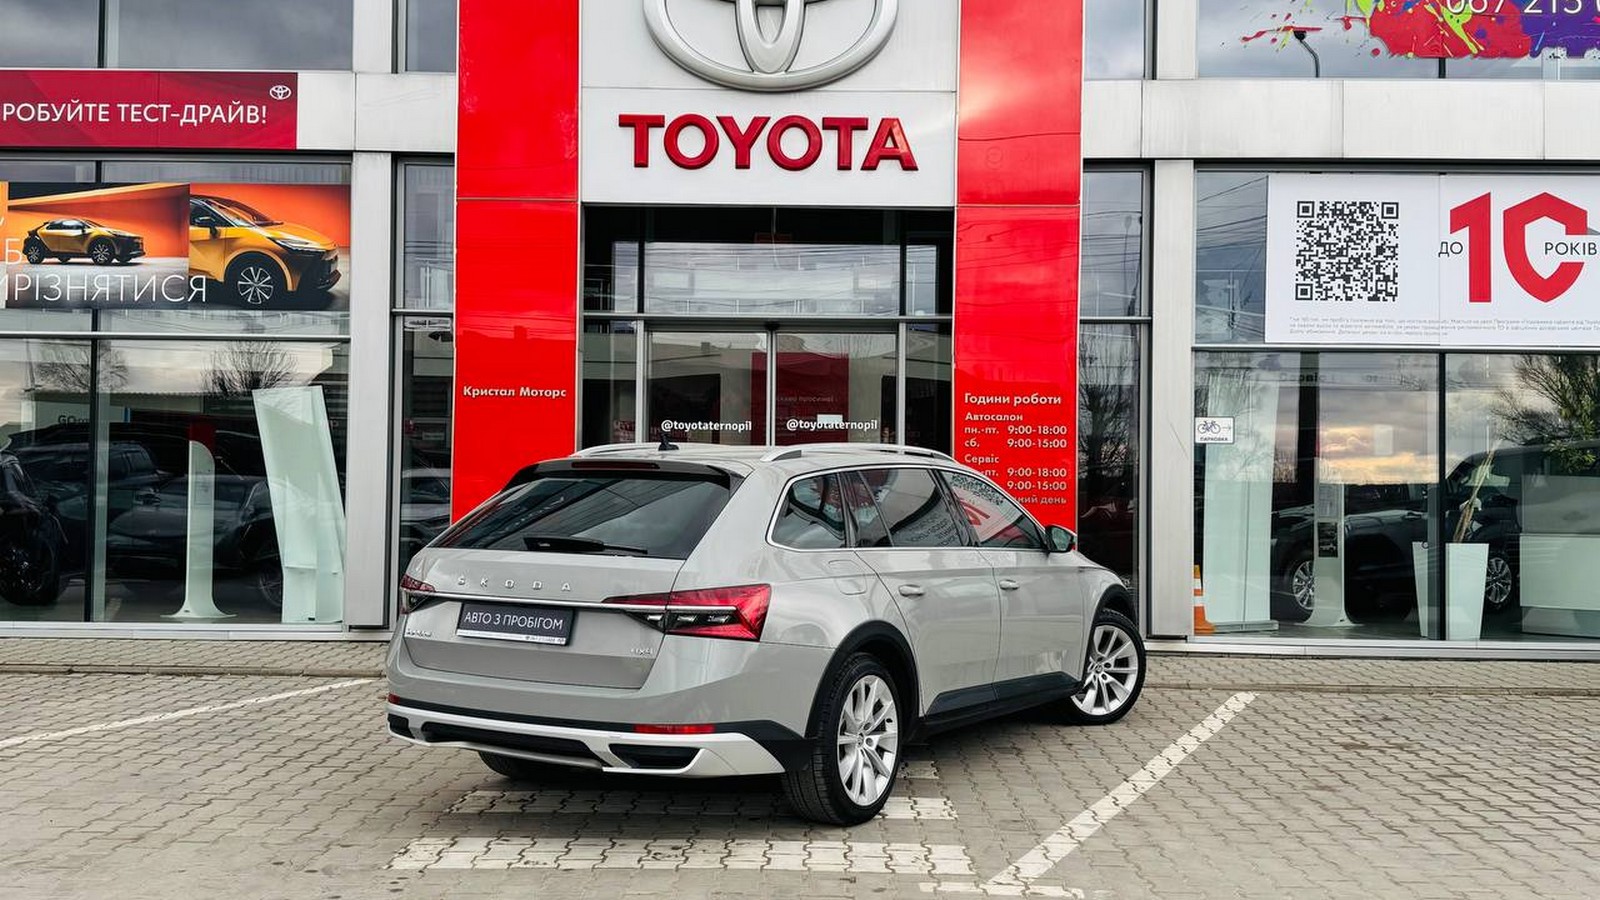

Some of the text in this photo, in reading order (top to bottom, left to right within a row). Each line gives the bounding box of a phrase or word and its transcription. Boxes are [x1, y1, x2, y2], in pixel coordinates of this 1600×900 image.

[3, 99, 267, 126] РОБУЙТЕ ТЕСТ-ДРАЙВ!
[618, 114, 919, 171] TOYOTA
[1438, 241, 1463, 258] ДО
[1544, 241, 1598, 256] РОКІВ
[463, 386, 567, 399] Кристал Моторс
[964, 393, 1062, 406] Години роботи
[965, 412, 1023, 421] Автосалон
[660, 419, 753, 434] @toyotaternopil
[786, 419, 878, 433] @toyotaternopil
[1007, 425, 1067, 435] 9:00-18:00
[964, 437, 1067, 448] сб. 9:00-15:00
[964, 454, 1000, 465] Сервіс
[1007, 468, 1067, 477] 9:00-18:00
[1006, 481, 1067, 491] 9:00-15:00
[1040, 497, 1067, 505] день
[464, 611, 492, 625] АВТО
[502, 614, 563, 631] ПРОБІГОМ
